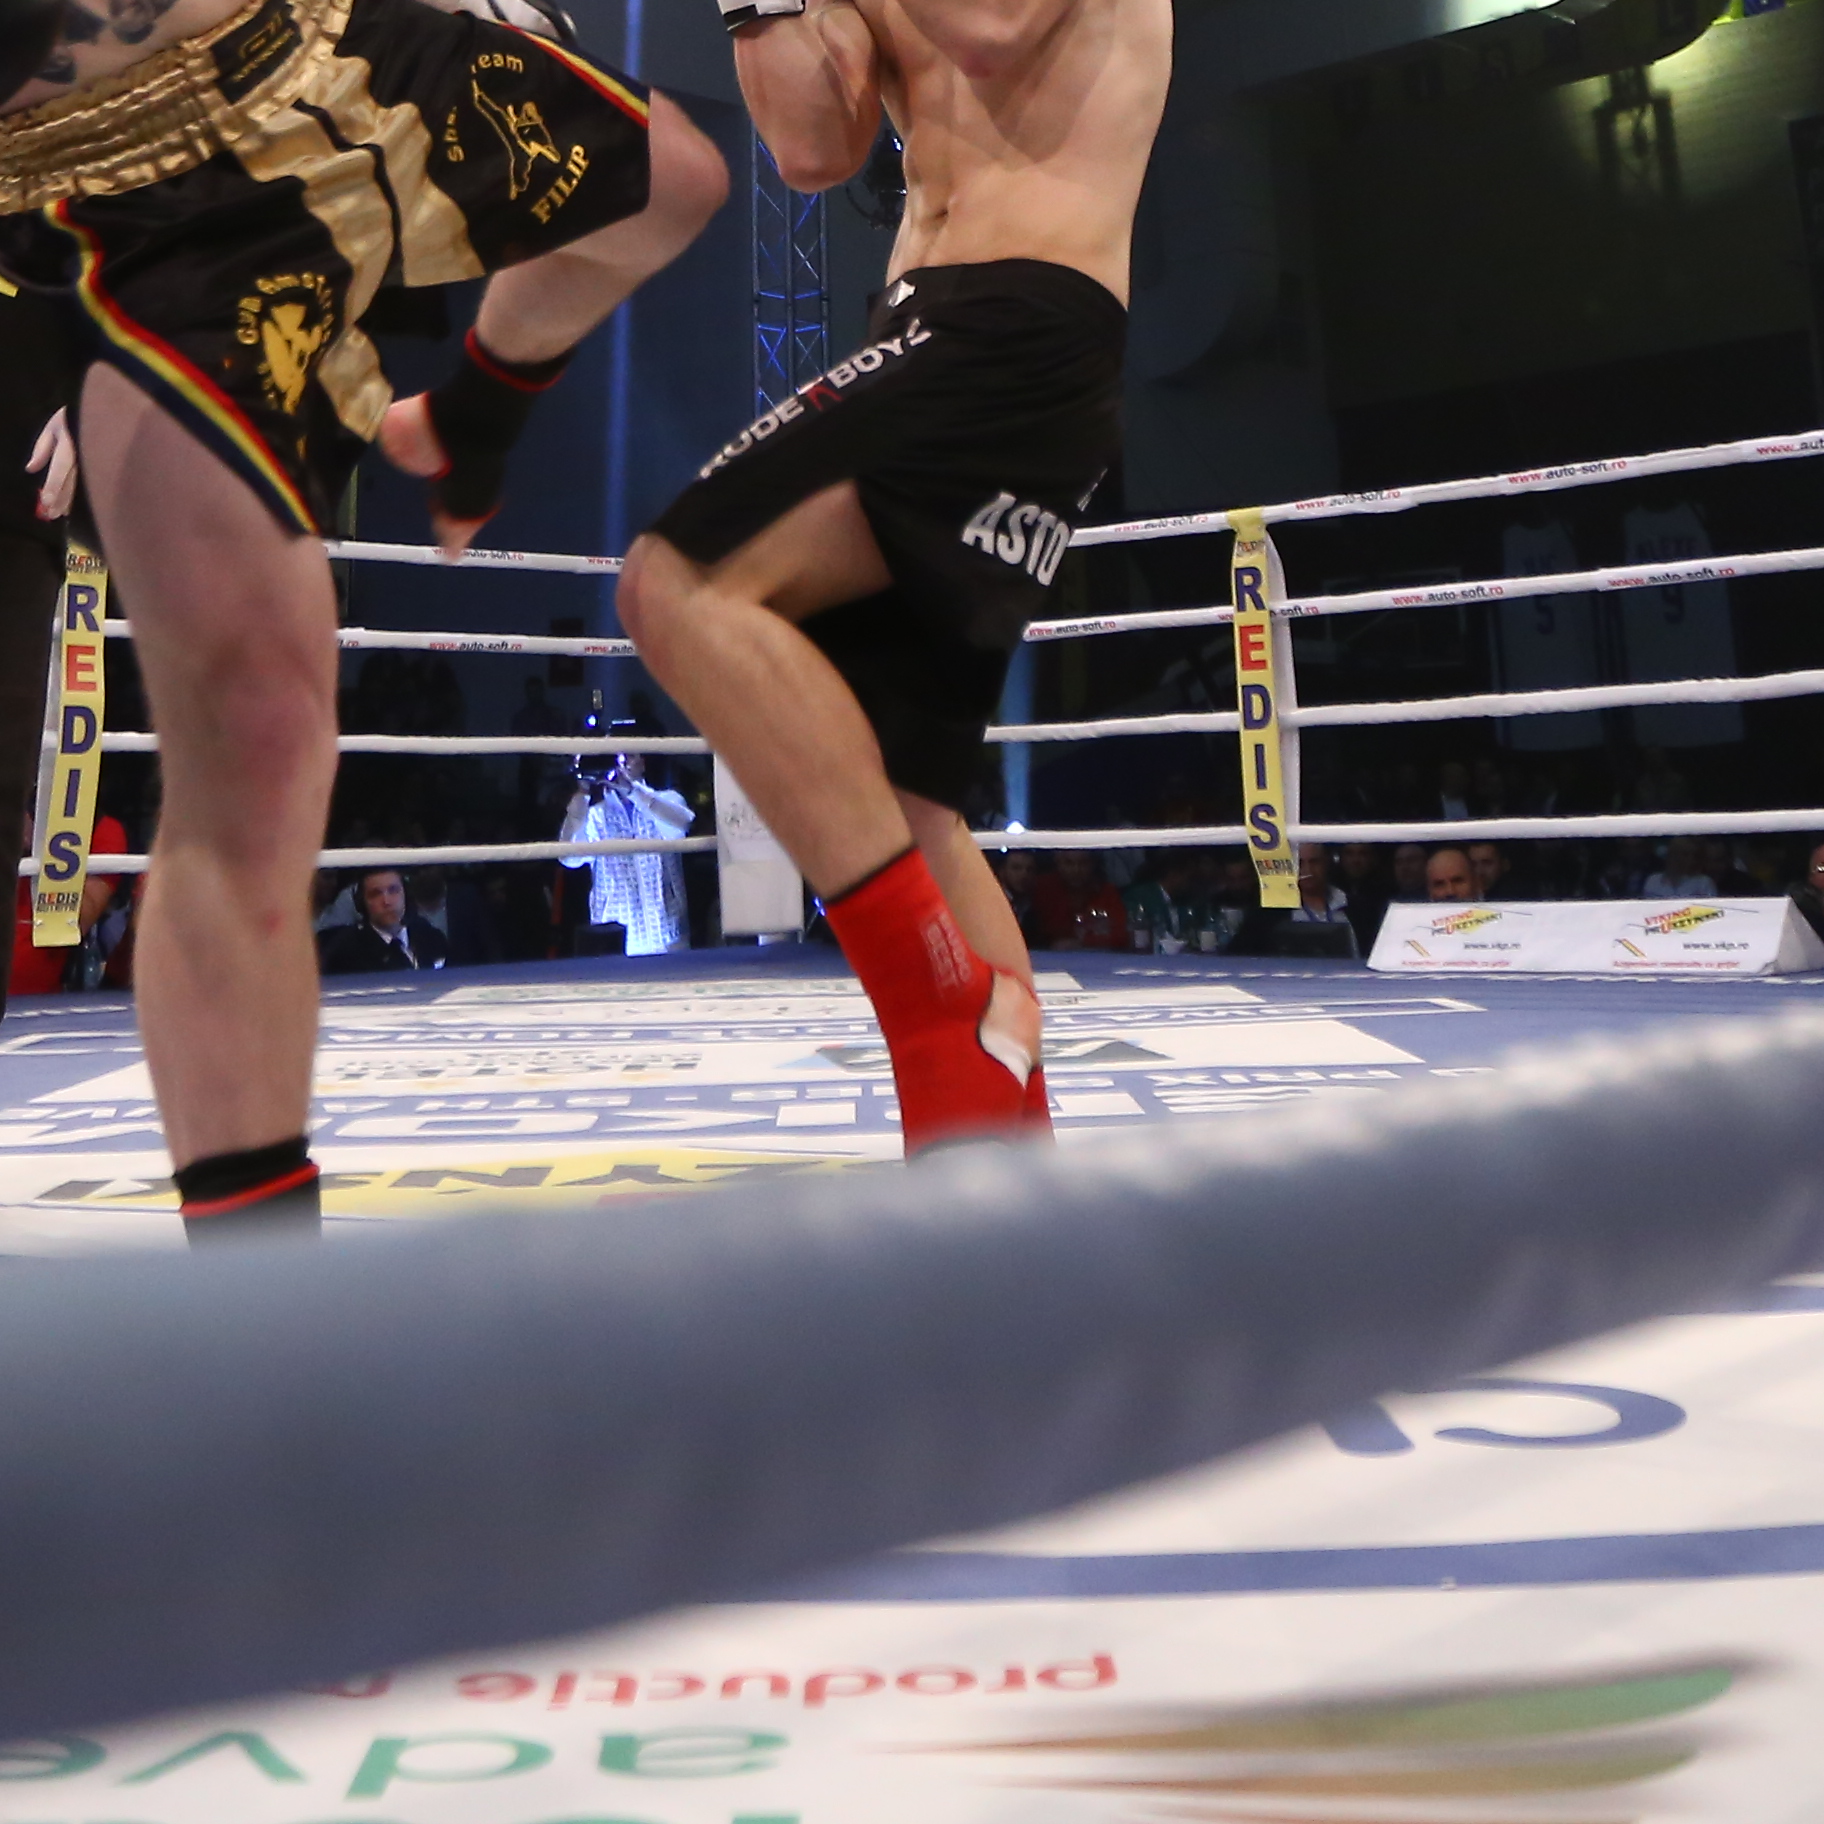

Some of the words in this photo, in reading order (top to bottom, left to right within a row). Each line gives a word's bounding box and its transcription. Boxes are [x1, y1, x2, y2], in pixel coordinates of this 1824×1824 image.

[531, 144, 589, 224] FILIP
[1392, 586, 1504, 606] www.auto-soft.ro
[43, 583, 101, 882] REDIS
[1235, 566, 1281, 852] REDIS
